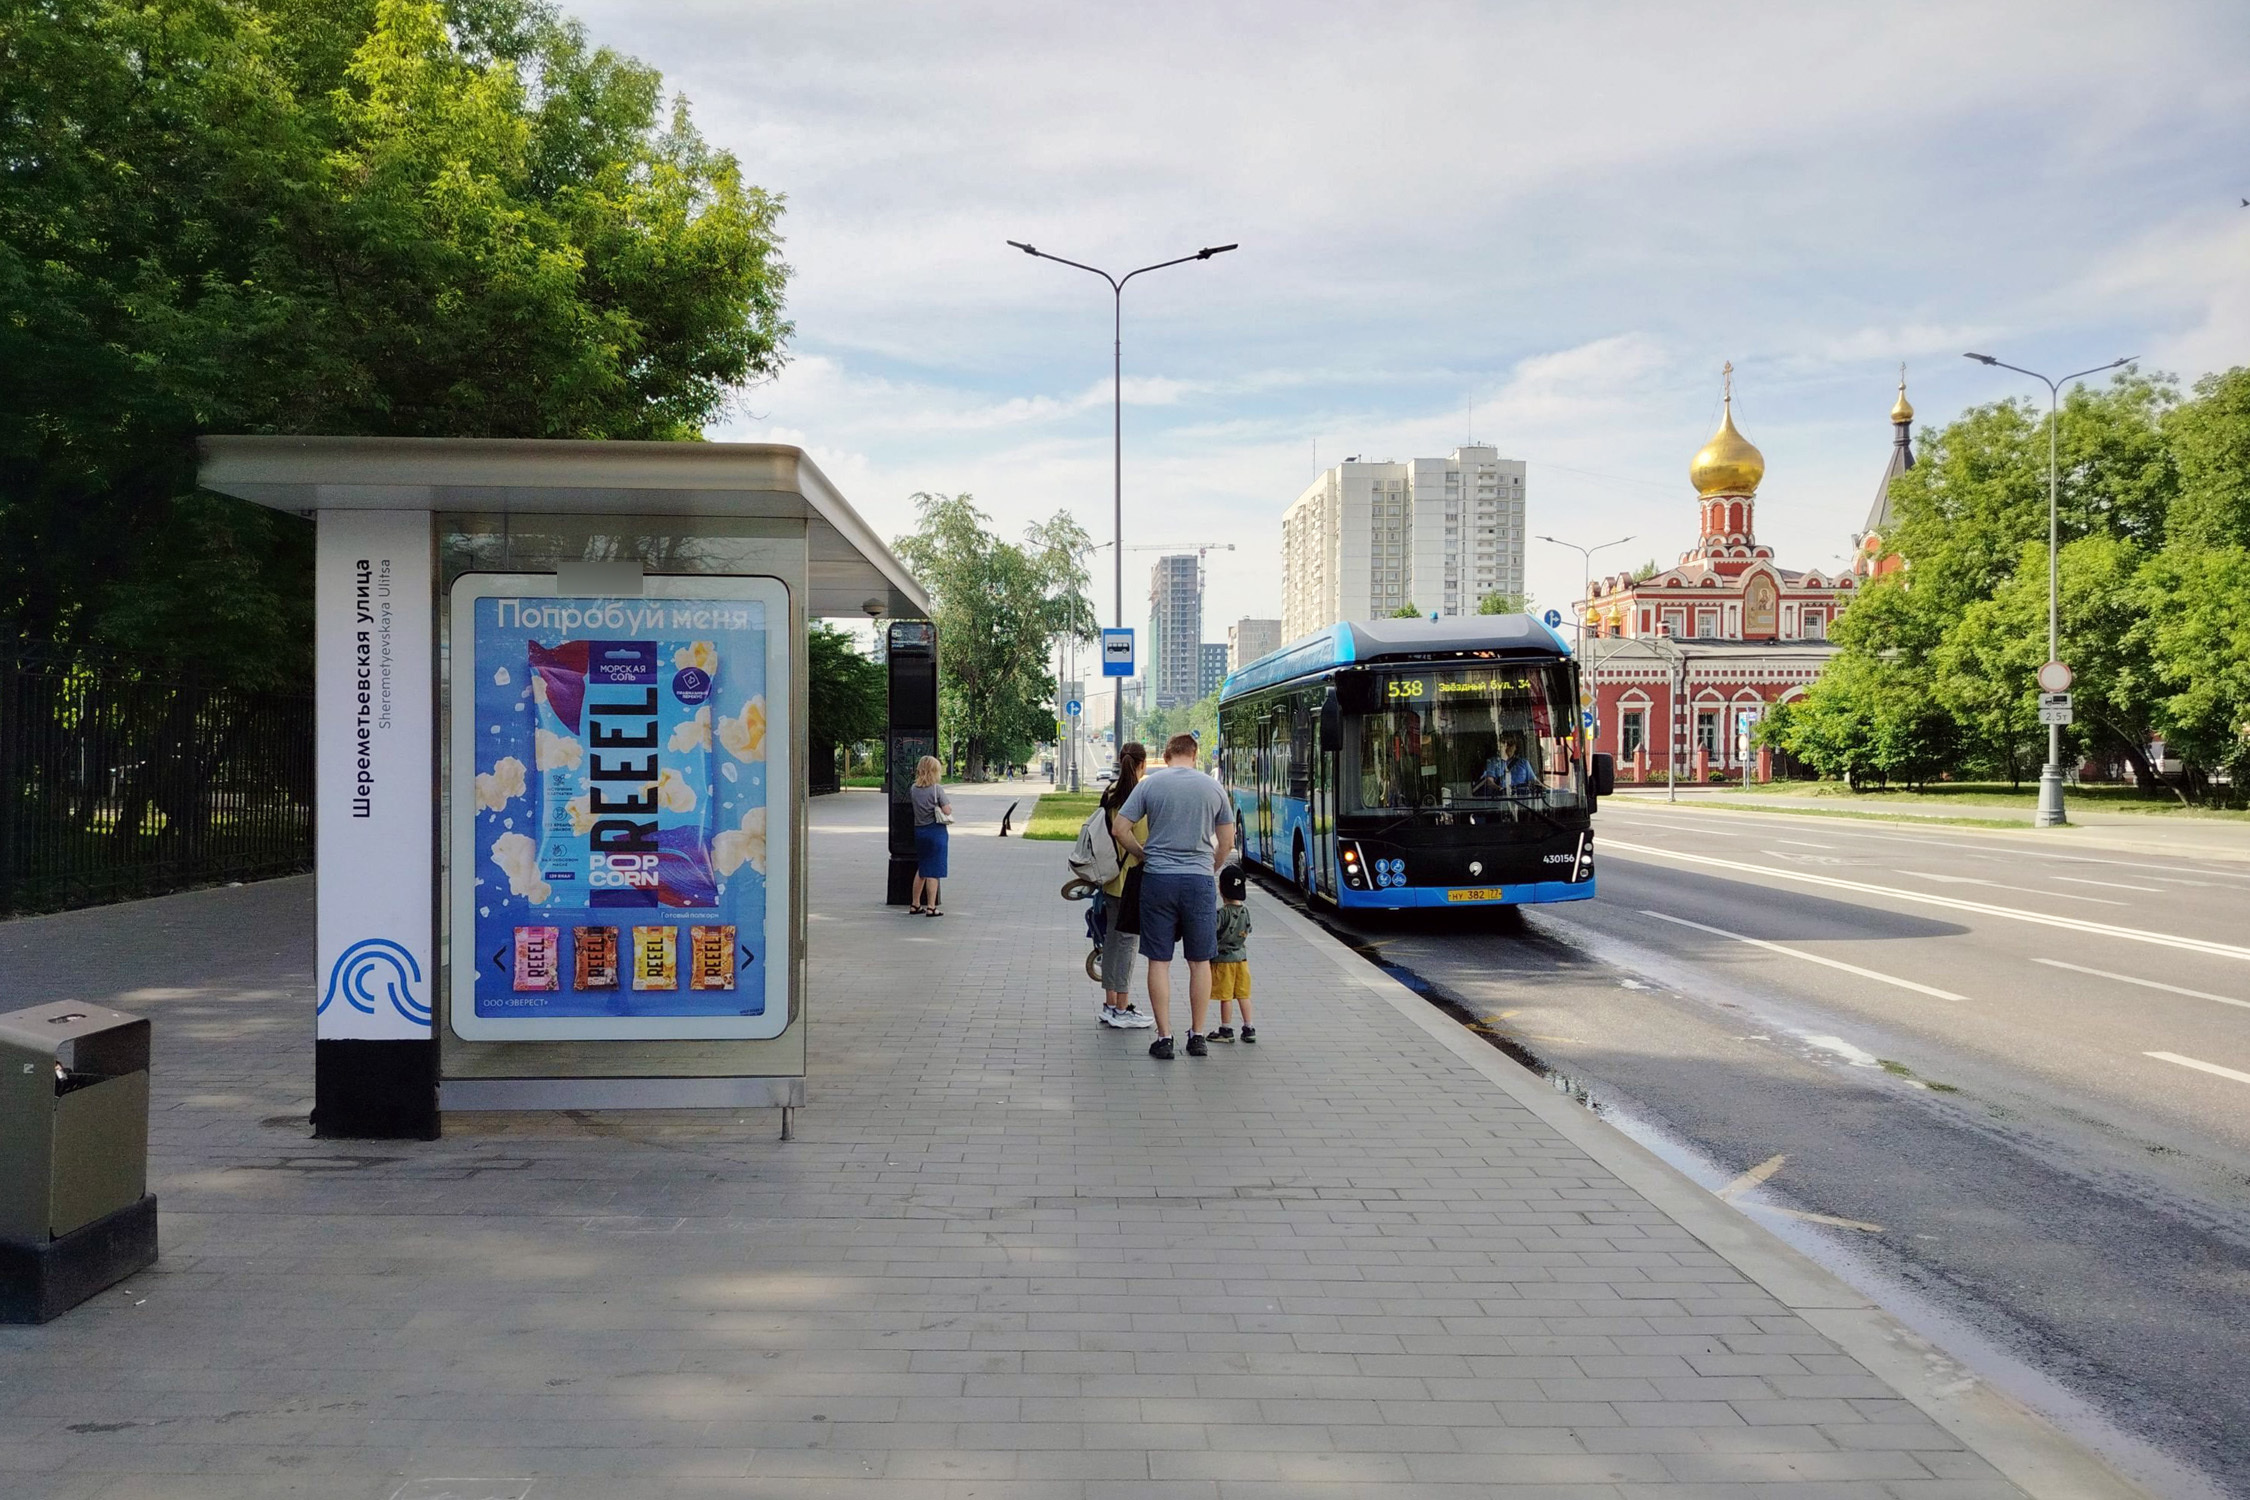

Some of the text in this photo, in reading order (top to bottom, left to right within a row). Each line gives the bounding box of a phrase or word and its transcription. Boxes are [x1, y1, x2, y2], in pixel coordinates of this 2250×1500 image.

[497, 599, 749, 636] Попробуй меня
[378, 559, 393, 729] Sheremetyevskaya Ulitsa
[600, 664, 646, 673] МОРСКАЯ
[610, 673, 636, 681] СОЛЬ
[353, 559, 374, 818] Шереметьевская улица
[1388, 679, 1531, 697] 538 Звёздный бул. 34
[589, 687, 658, 852] REEEL
[590, 854, 659, 870] POP
[1542, 854, 1575, 864] 430156
[588, 871, 659, 886] CORN
[1233, 878, 1241, 886] P
[1467, 891, 1485, 900] 382
[527, 938, 545, 977] REEEL
[587, 937, 605, 977] REEEL
[647, 938, 663, 977] REEEL
[704, 937, 721, 977] REEEL
[483, 999, 504, 1007] ООО
